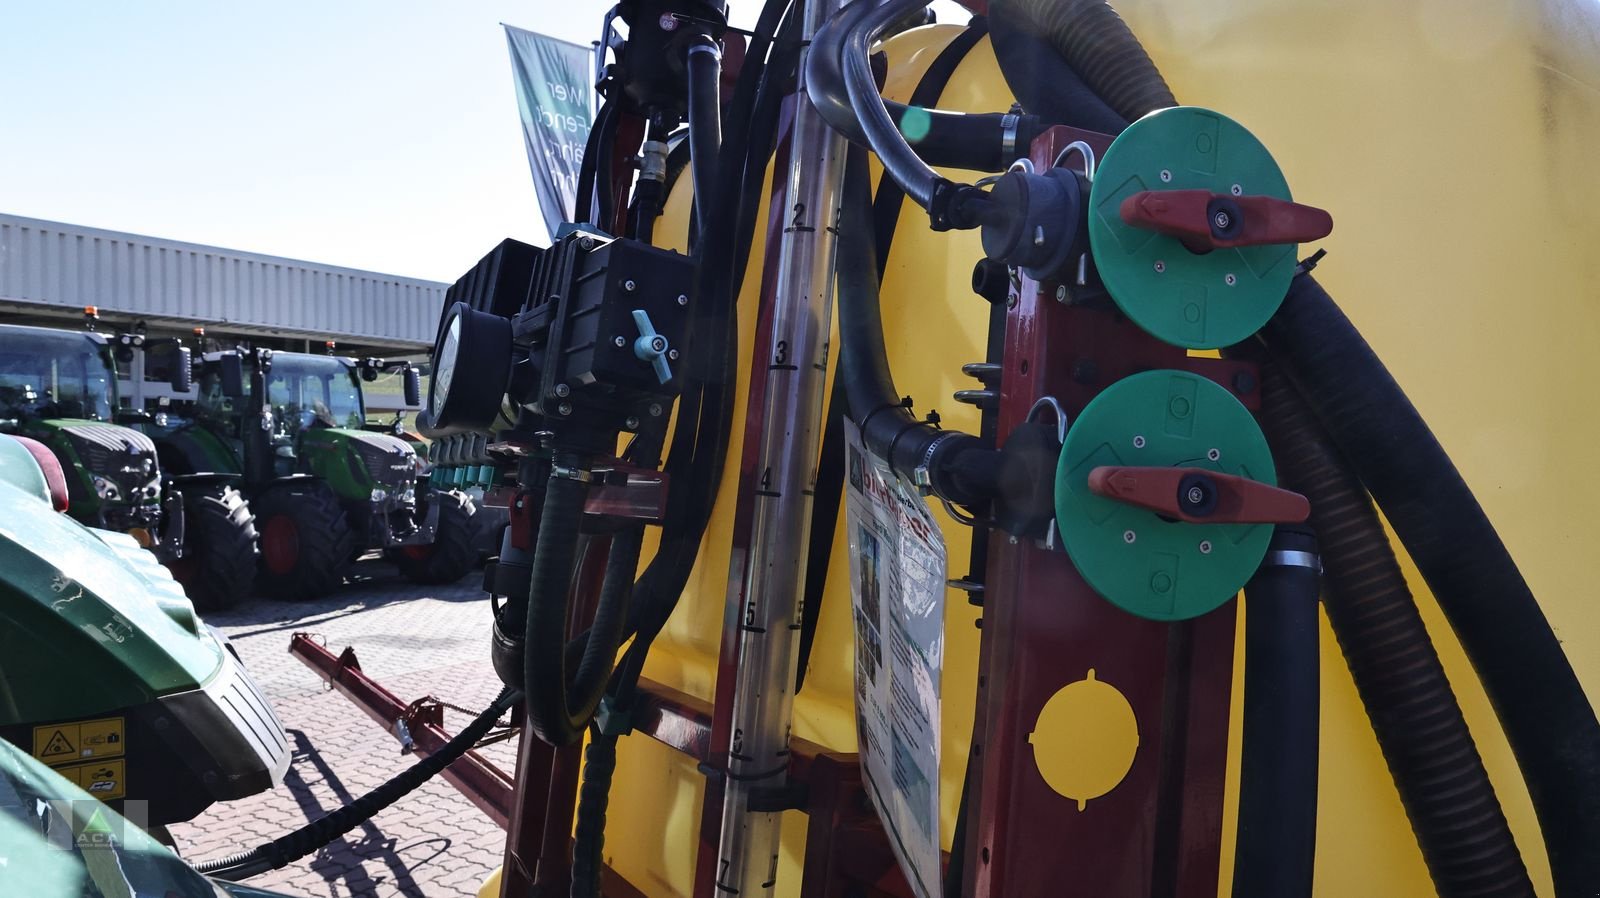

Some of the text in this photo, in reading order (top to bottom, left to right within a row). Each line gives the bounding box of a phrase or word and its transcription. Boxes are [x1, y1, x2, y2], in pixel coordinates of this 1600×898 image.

[792, 203, 805, 226] 2
[775, 340, 788, 364] 3
[760, 467, 771, 490] 4
[746, 601, 755, 626] 5
[720, 858, 730, 883] 7
